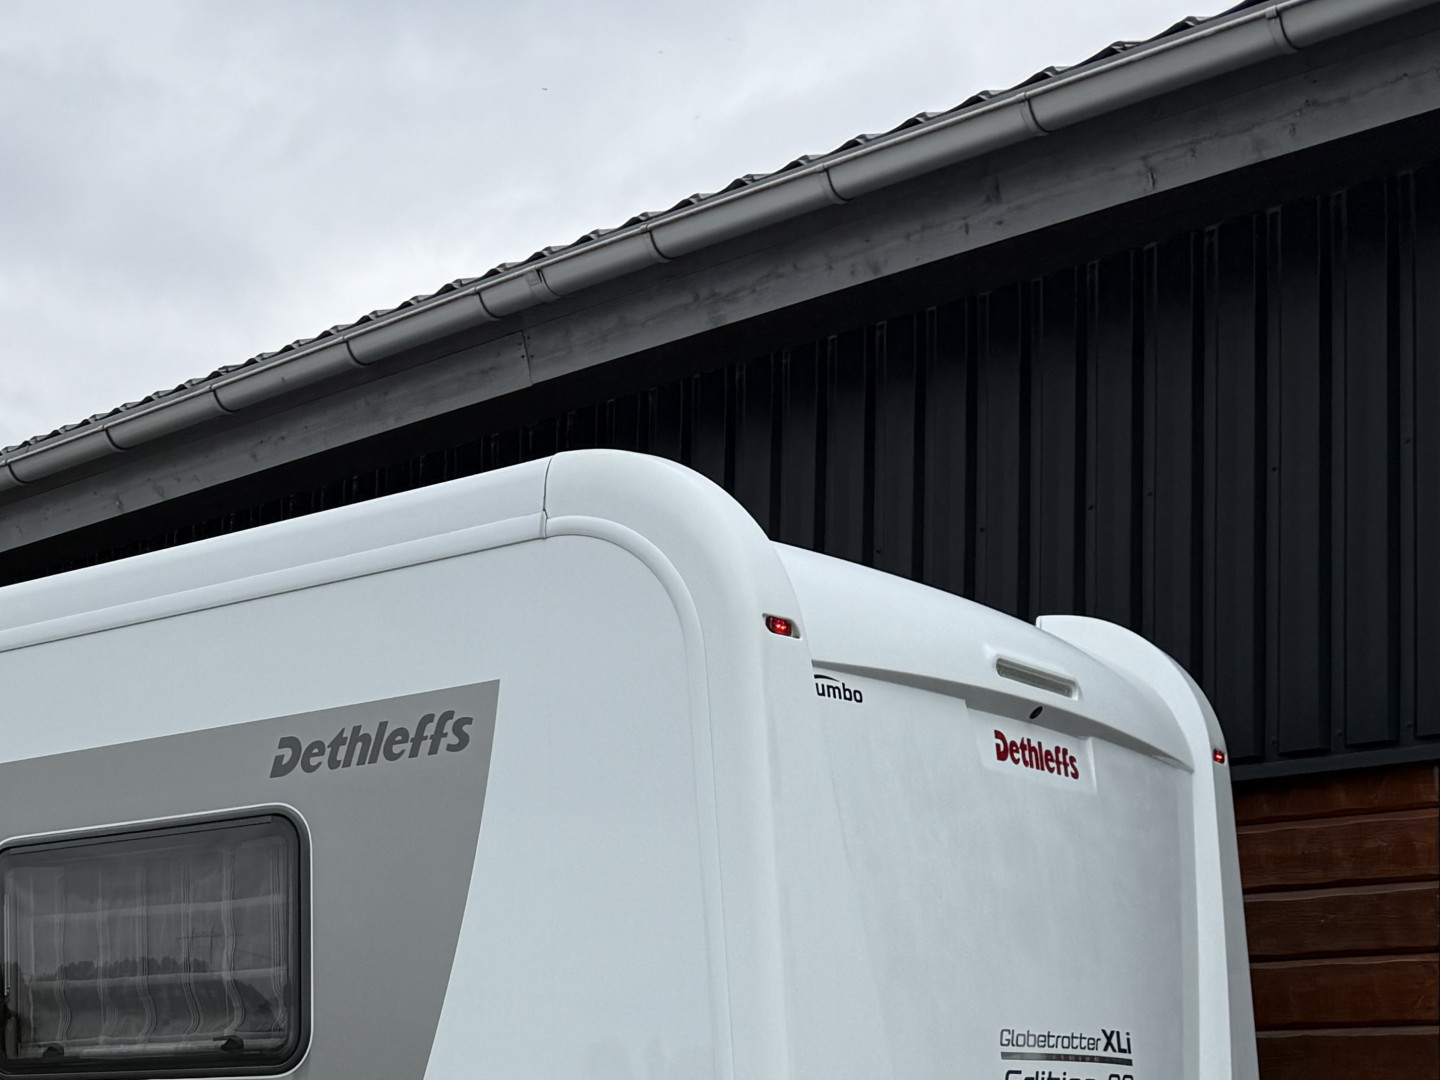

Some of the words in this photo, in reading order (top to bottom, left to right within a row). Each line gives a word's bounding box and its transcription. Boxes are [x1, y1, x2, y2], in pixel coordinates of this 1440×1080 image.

[815, 682, 863, 703] umbo
[270, 710, 474, 778] Dethleffs
[993, 730, 1079, 780] Dethleffs
